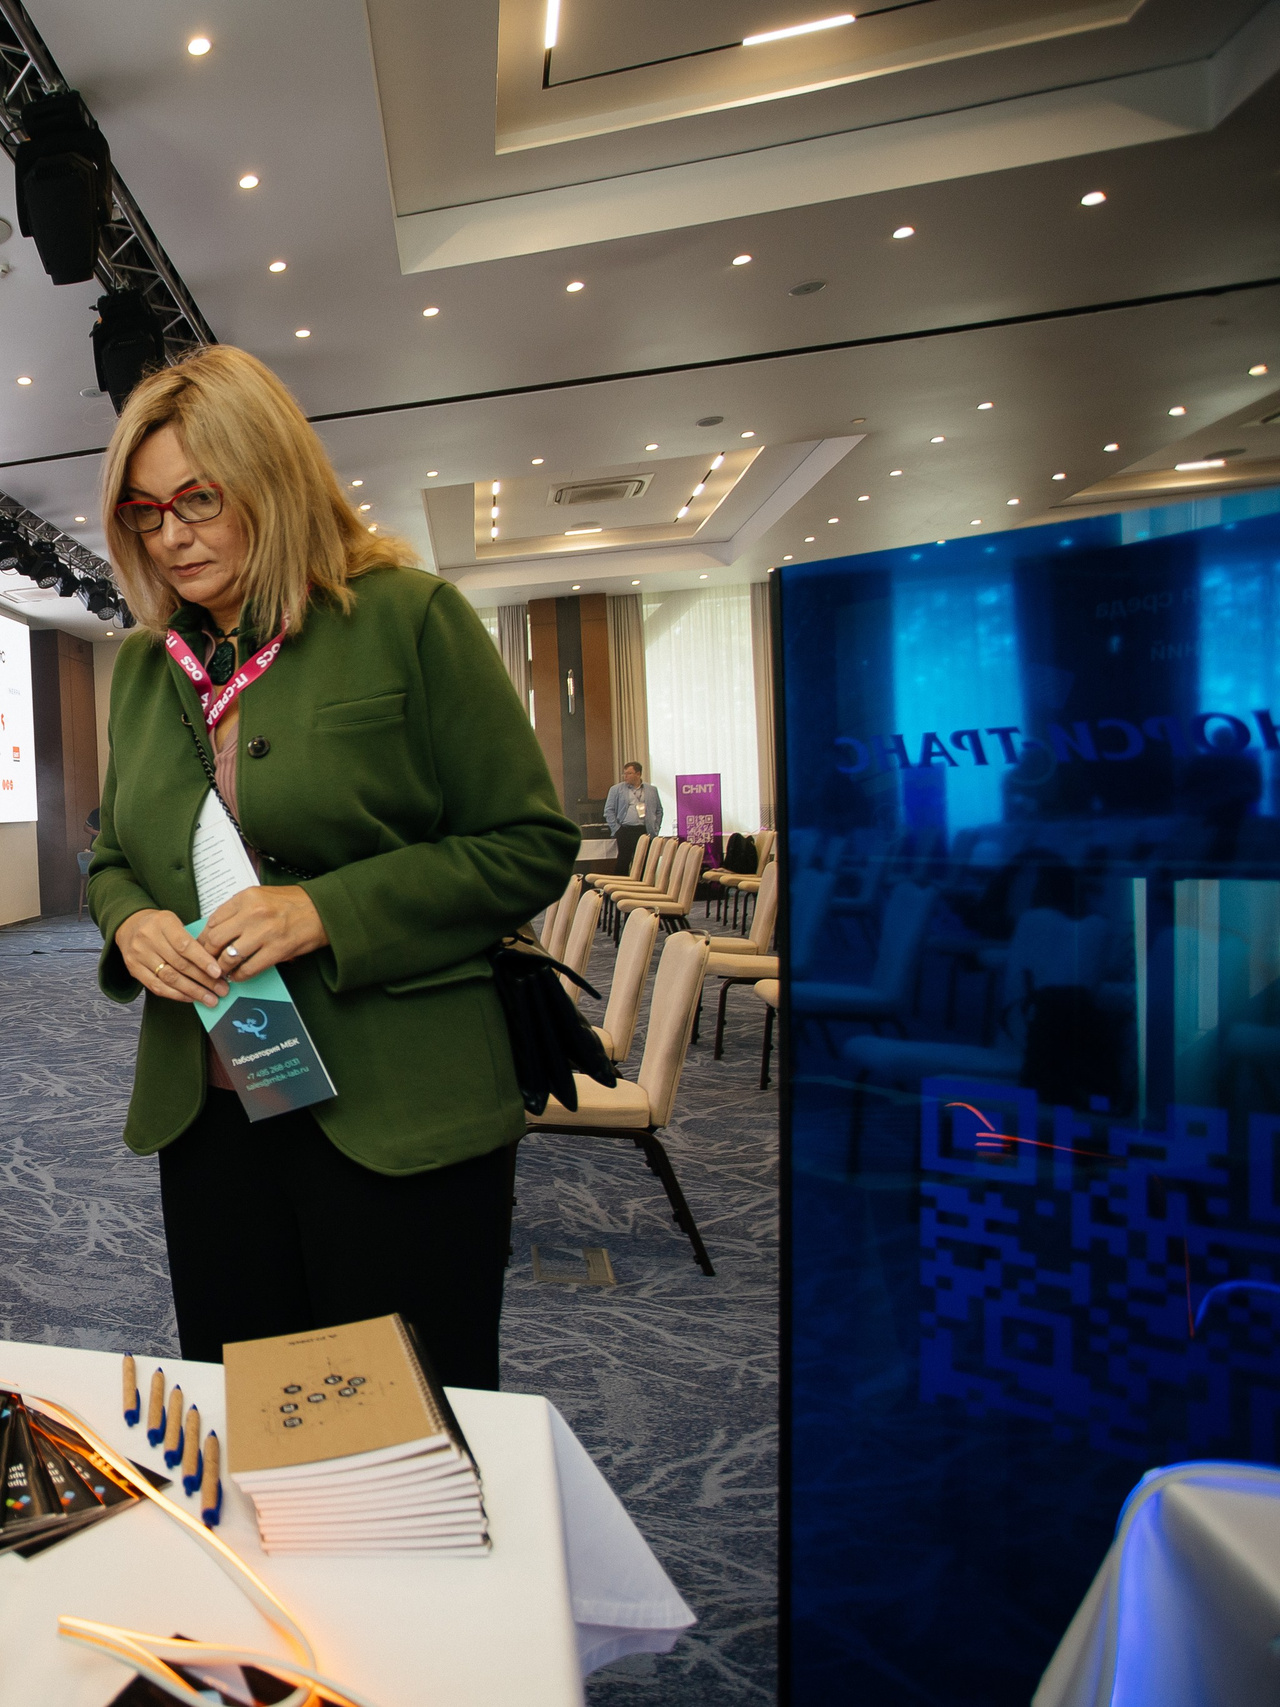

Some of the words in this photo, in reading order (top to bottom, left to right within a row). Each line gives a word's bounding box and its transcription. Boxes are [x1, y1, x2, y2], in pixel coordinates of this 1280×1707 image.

[180, 655, 203, 681] OCS
[255, 642, 281, 668] OCS
[231, 1045, 281, 1067] Лаборатория
